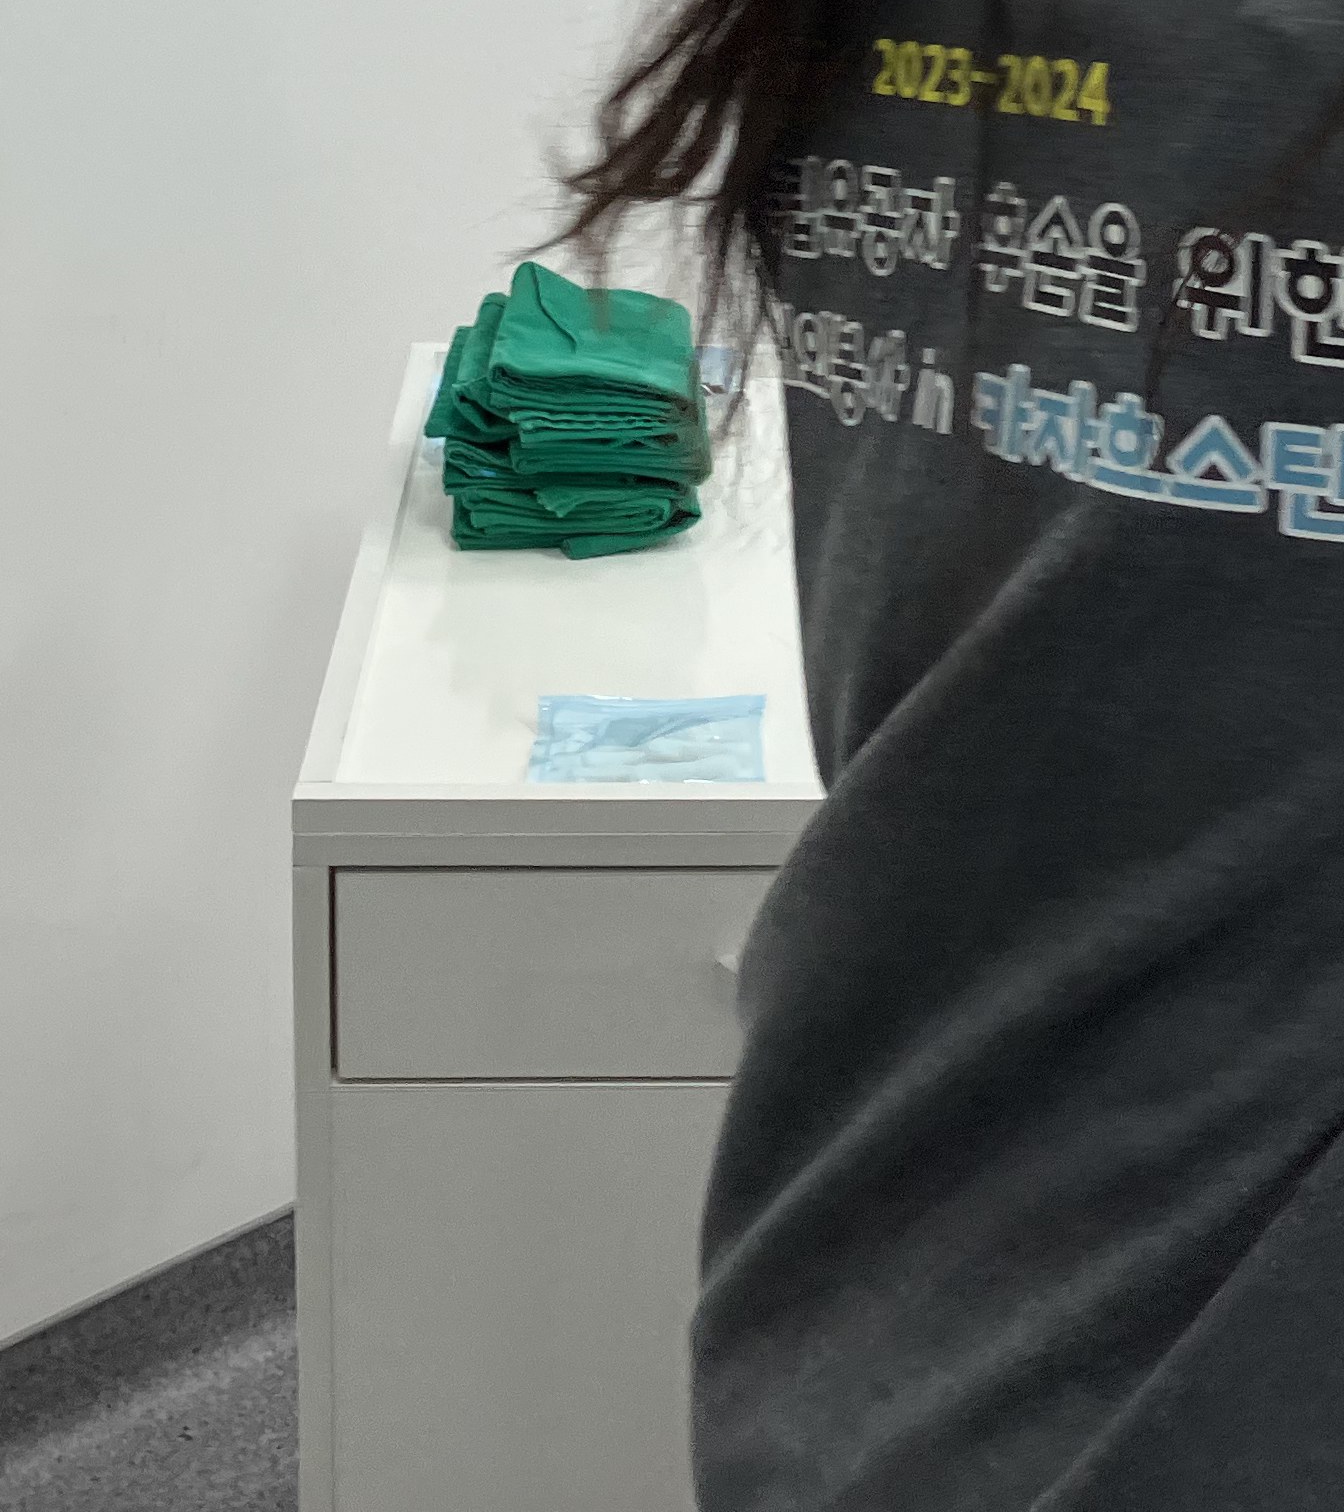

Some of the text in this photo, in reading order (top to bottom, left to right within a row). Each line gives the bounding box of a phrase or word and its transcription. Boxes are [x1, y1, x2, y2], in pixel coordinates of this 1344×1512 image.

[870, 38, 1111, 126] 2023-2024
[977, 182, 1147, 332] 후손을
[911, 347, 954, 435] in
